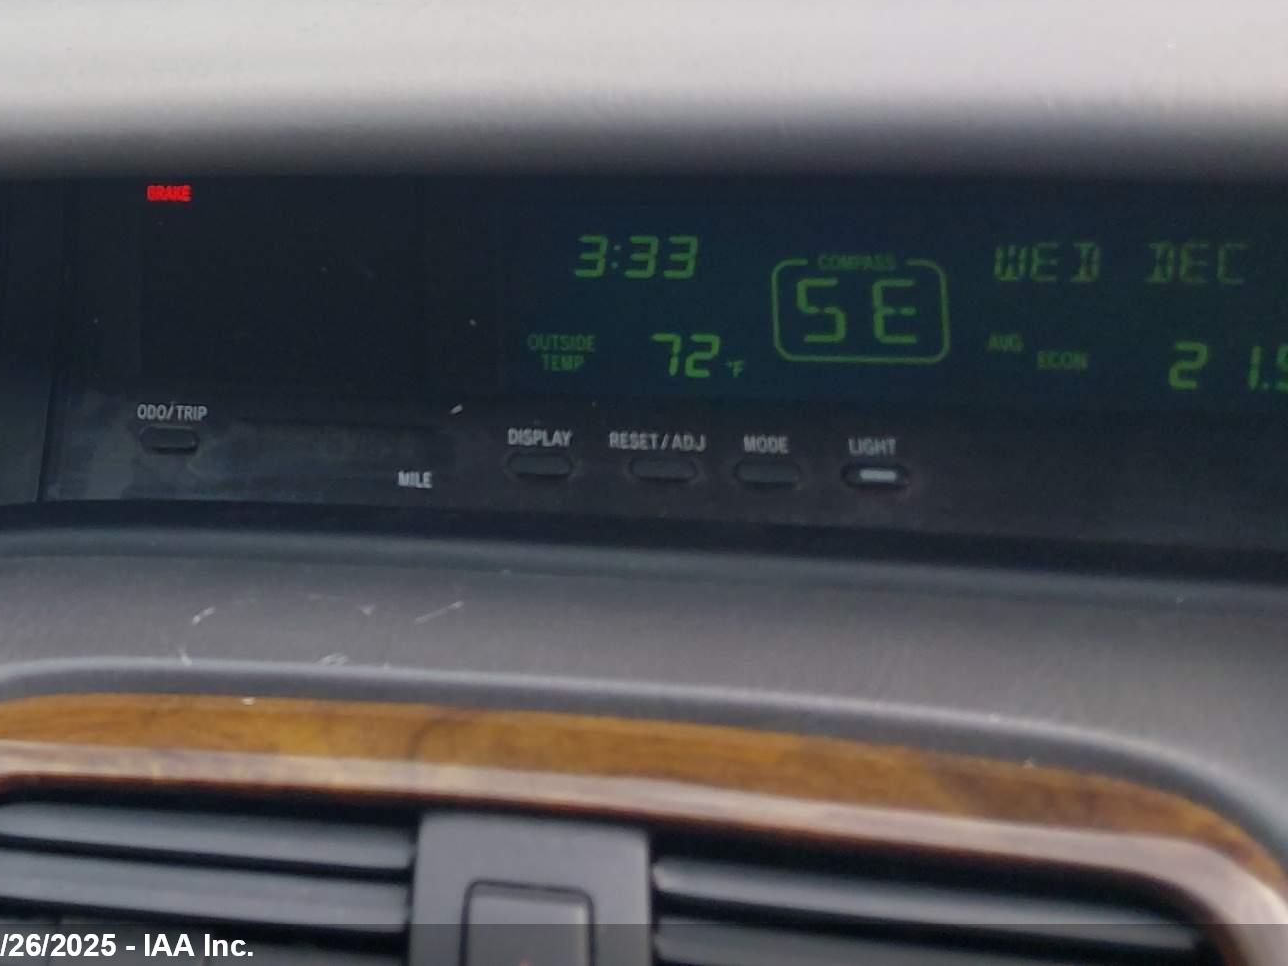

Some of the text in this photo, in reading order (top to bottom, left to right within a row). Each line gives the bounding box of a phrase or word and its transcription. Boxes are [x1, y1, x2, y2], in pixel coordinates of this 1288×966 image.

[146, 185, 192, 202] BRAKE
[574, 235, 698, 279] 3:33
[993, 241, 1246, 285] WED DEC
[796, 277, 918, 344] SE
[527, 333, 596, 351] OUTSIDE
[988, 334, 1025, 352] AVG
[542, 354, 585, 371] TEMP
[651, 333, 721, 378] 72
[137, 403, 208, 421] ODO/TRIP
[508, 428, 572, 447] DISPLAY
[609, 432, 706, 452] RESET/ADJ
[743, 436, 789, 454] MODE
[848, 438, 897, 456] LIGHT
[398, 471, 433, 489] MILE
